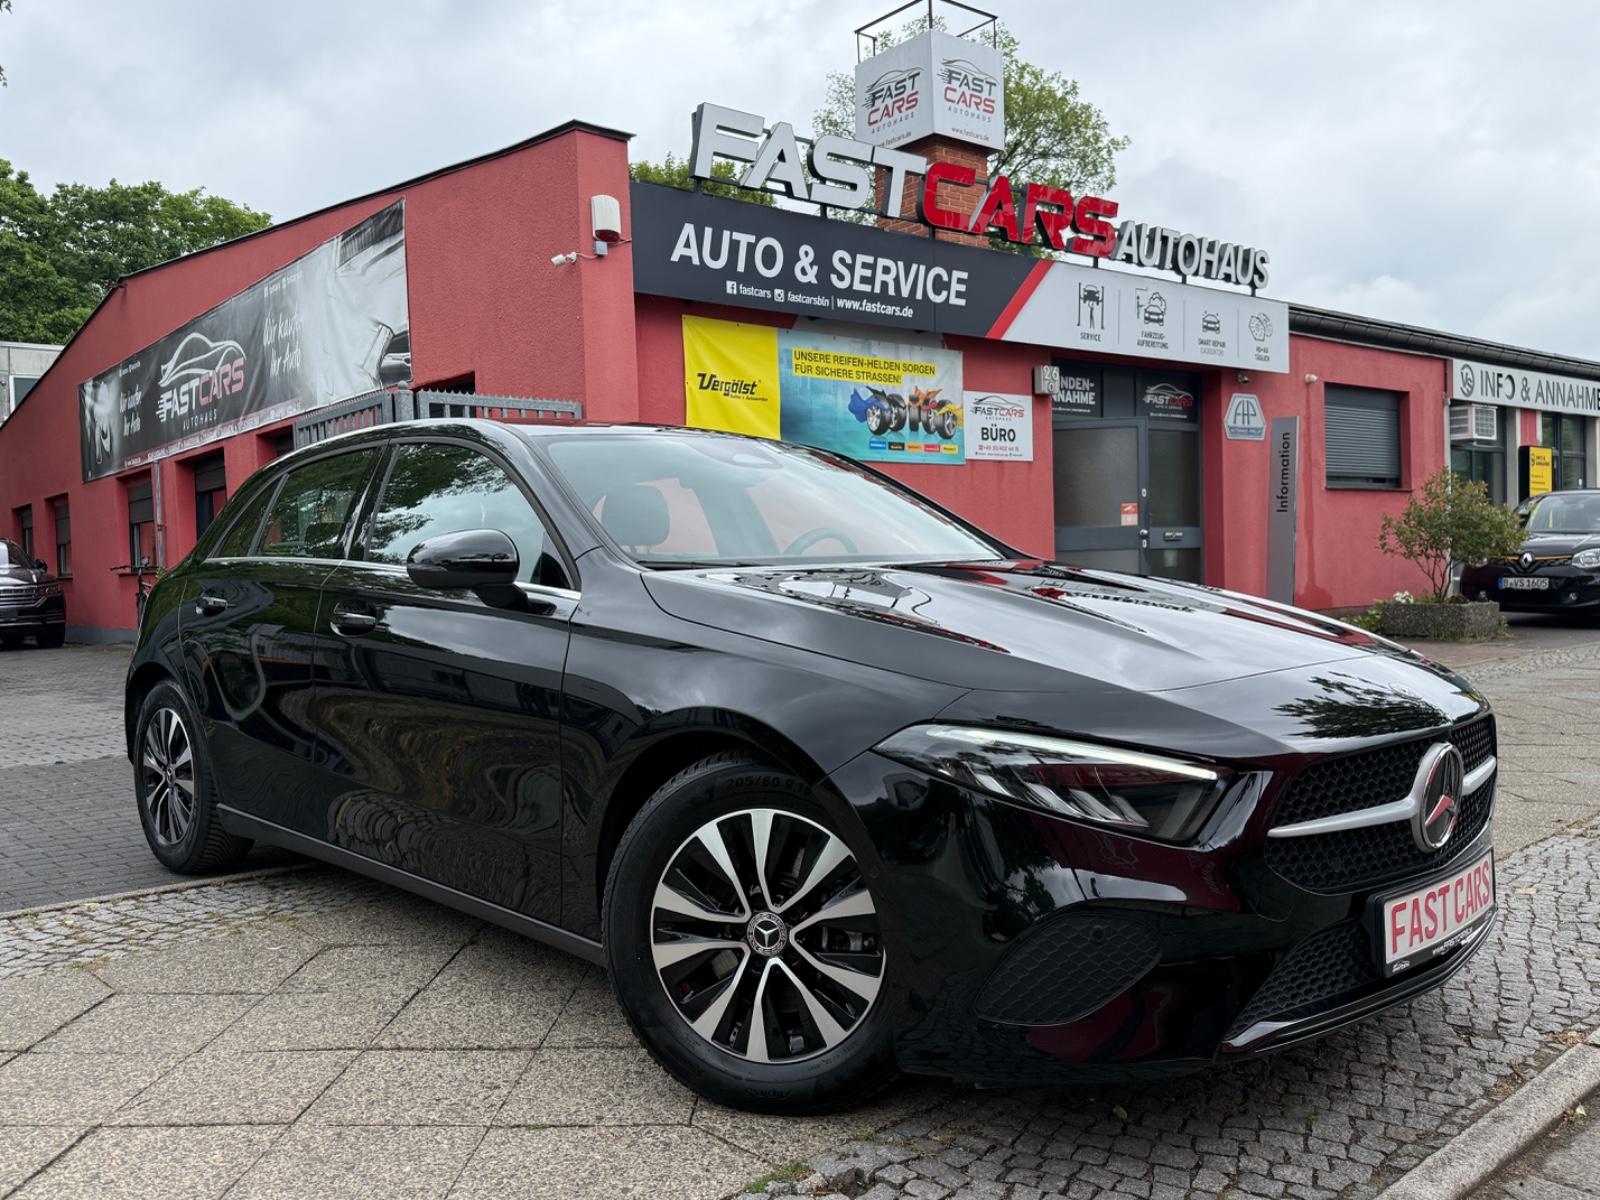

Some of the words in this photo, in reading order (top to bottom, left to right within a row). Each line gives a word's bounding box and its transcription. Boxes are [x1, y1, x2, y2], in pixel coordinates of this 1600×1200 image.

[871, 72, 921, 106] FAST
[948, 68, 997, 97] FAST
[867, 91, 919, 126] CARS
[944, 86, 996, 115] CARS
[871, 111, 915, 134] AUTOHAUS
[948, 106, 992, 123] AUTOHAUS
[670, 223, 784, 278] AUTO
[794, 244, 818, 284] &
[830, 250, 968, 306] SERVICE
[1113, 220, 1269, 289] AUTOHAUS
[739, 283, 772, 299] fastcars
[837, 298, 914, 318] www.fastcars.de
[1080, 331, 1101, 342] SERVICE
[794, 350, 831, 363] UNSERE
[833, 355, 900, 371] REIFEN-HELDEN
[902, 363, 935, 375] SORGEN
[794, 363, 813, 374] FÜR
[815, 366, 854, 379] SICHERE
[855, 370, 902, 384] STRASSEN!
[1043, 365, 1059, 380] 26
[697, 373, 757, 396] Vergölst
[1520, 376, 1531, 402] &
[183, 408, 217, 431] AUTOHAUS
[981, 423, 1016, 442] BÜRO
[1276, 432, 1290, 513] Information
[1391, 884, 1450, 954] FAST
[1454, 859, 1490, 923] CARS
